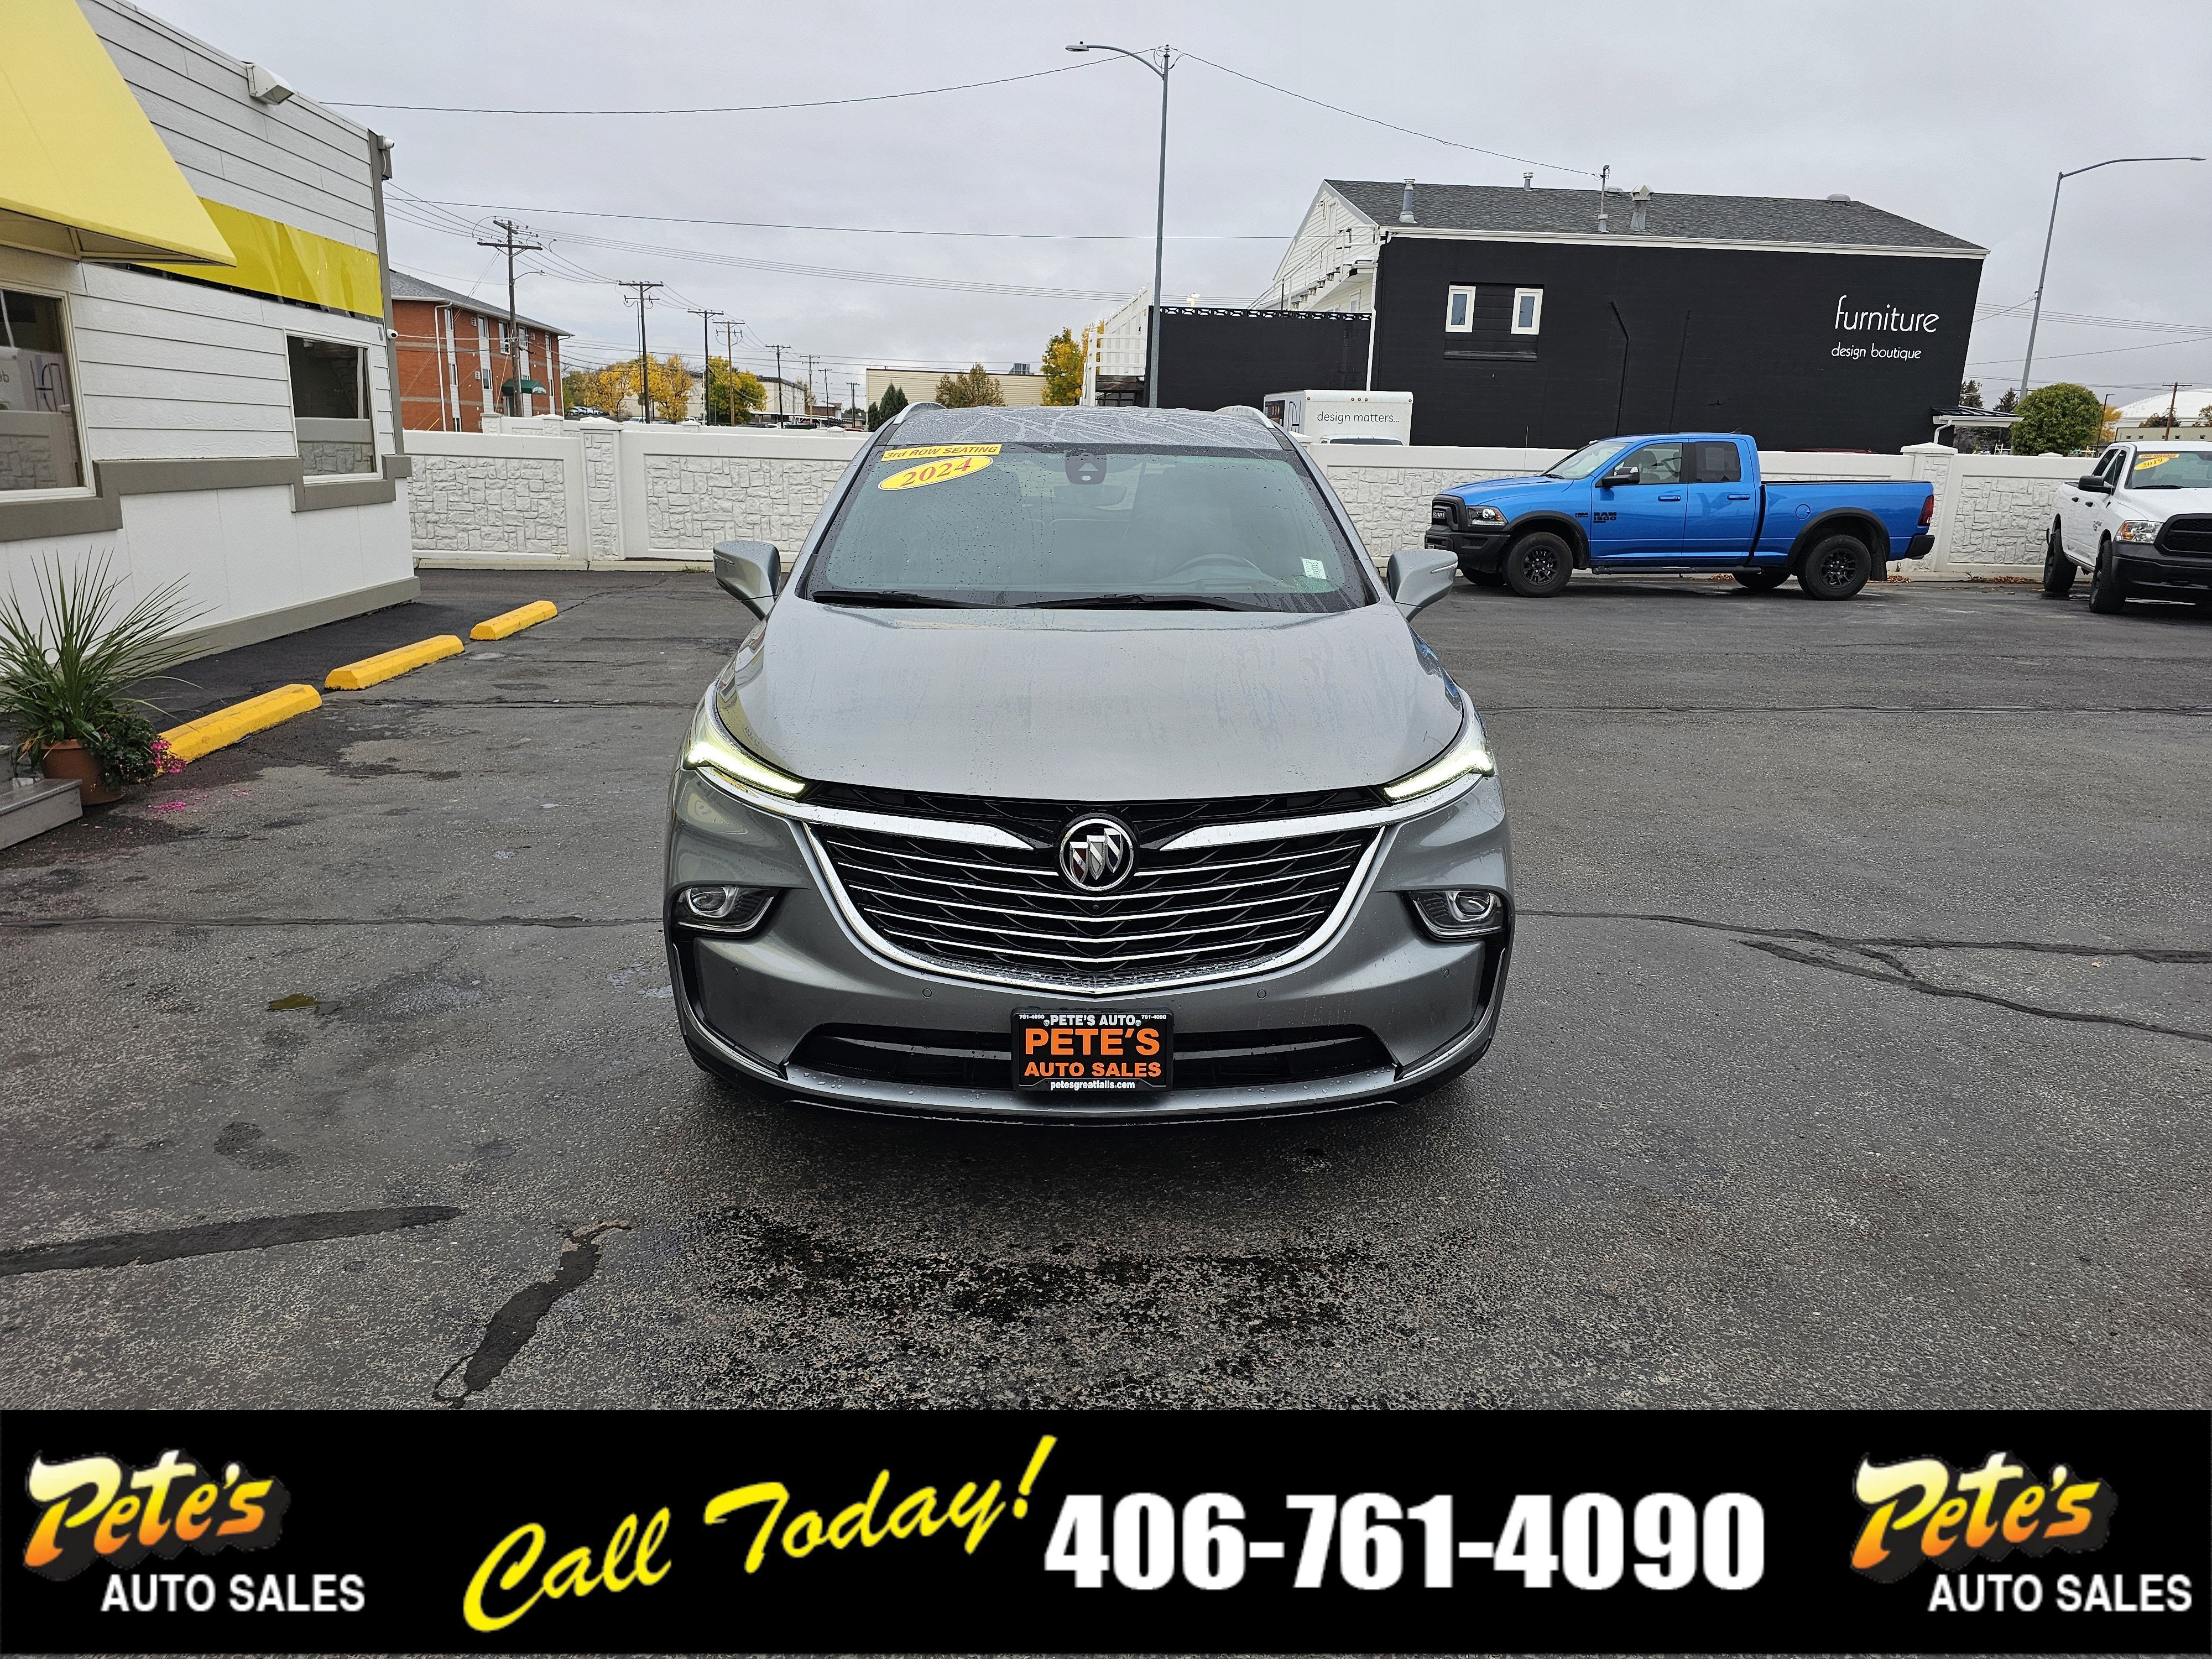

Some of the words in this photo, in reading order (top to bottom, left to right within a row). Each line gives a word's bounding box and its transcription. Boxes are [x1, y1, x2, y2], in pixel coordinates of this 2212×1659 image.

[1834, 295, 1939, 333] furniture
[1831, 342, 1866, 360] design
[1871, 342, 1922, 361] boutique
[1317, 411, 1350, 424] design
[1353, 413, 1400, 423] matters...
[884, 451, 907, 460] 3rd
[909, 448, 941, 457] ROW
[942, 446, 999, 455] SEATING
[2142, 458, 2163, 468] 2019
[900, 458, 973, 487] 2024
[1050, 1014, 1095, 1026] PETE'S
[1099, 1014, 1136, 1026] AUTO
[1025, 1028, 1160, 1056] PETE'S
[1024, 1062, 1084, 1077] AUTO
[1092, 1062, 1161, 1077] SALES
[1050, 1081, 1135, 1091] petesgreatfalls.com
